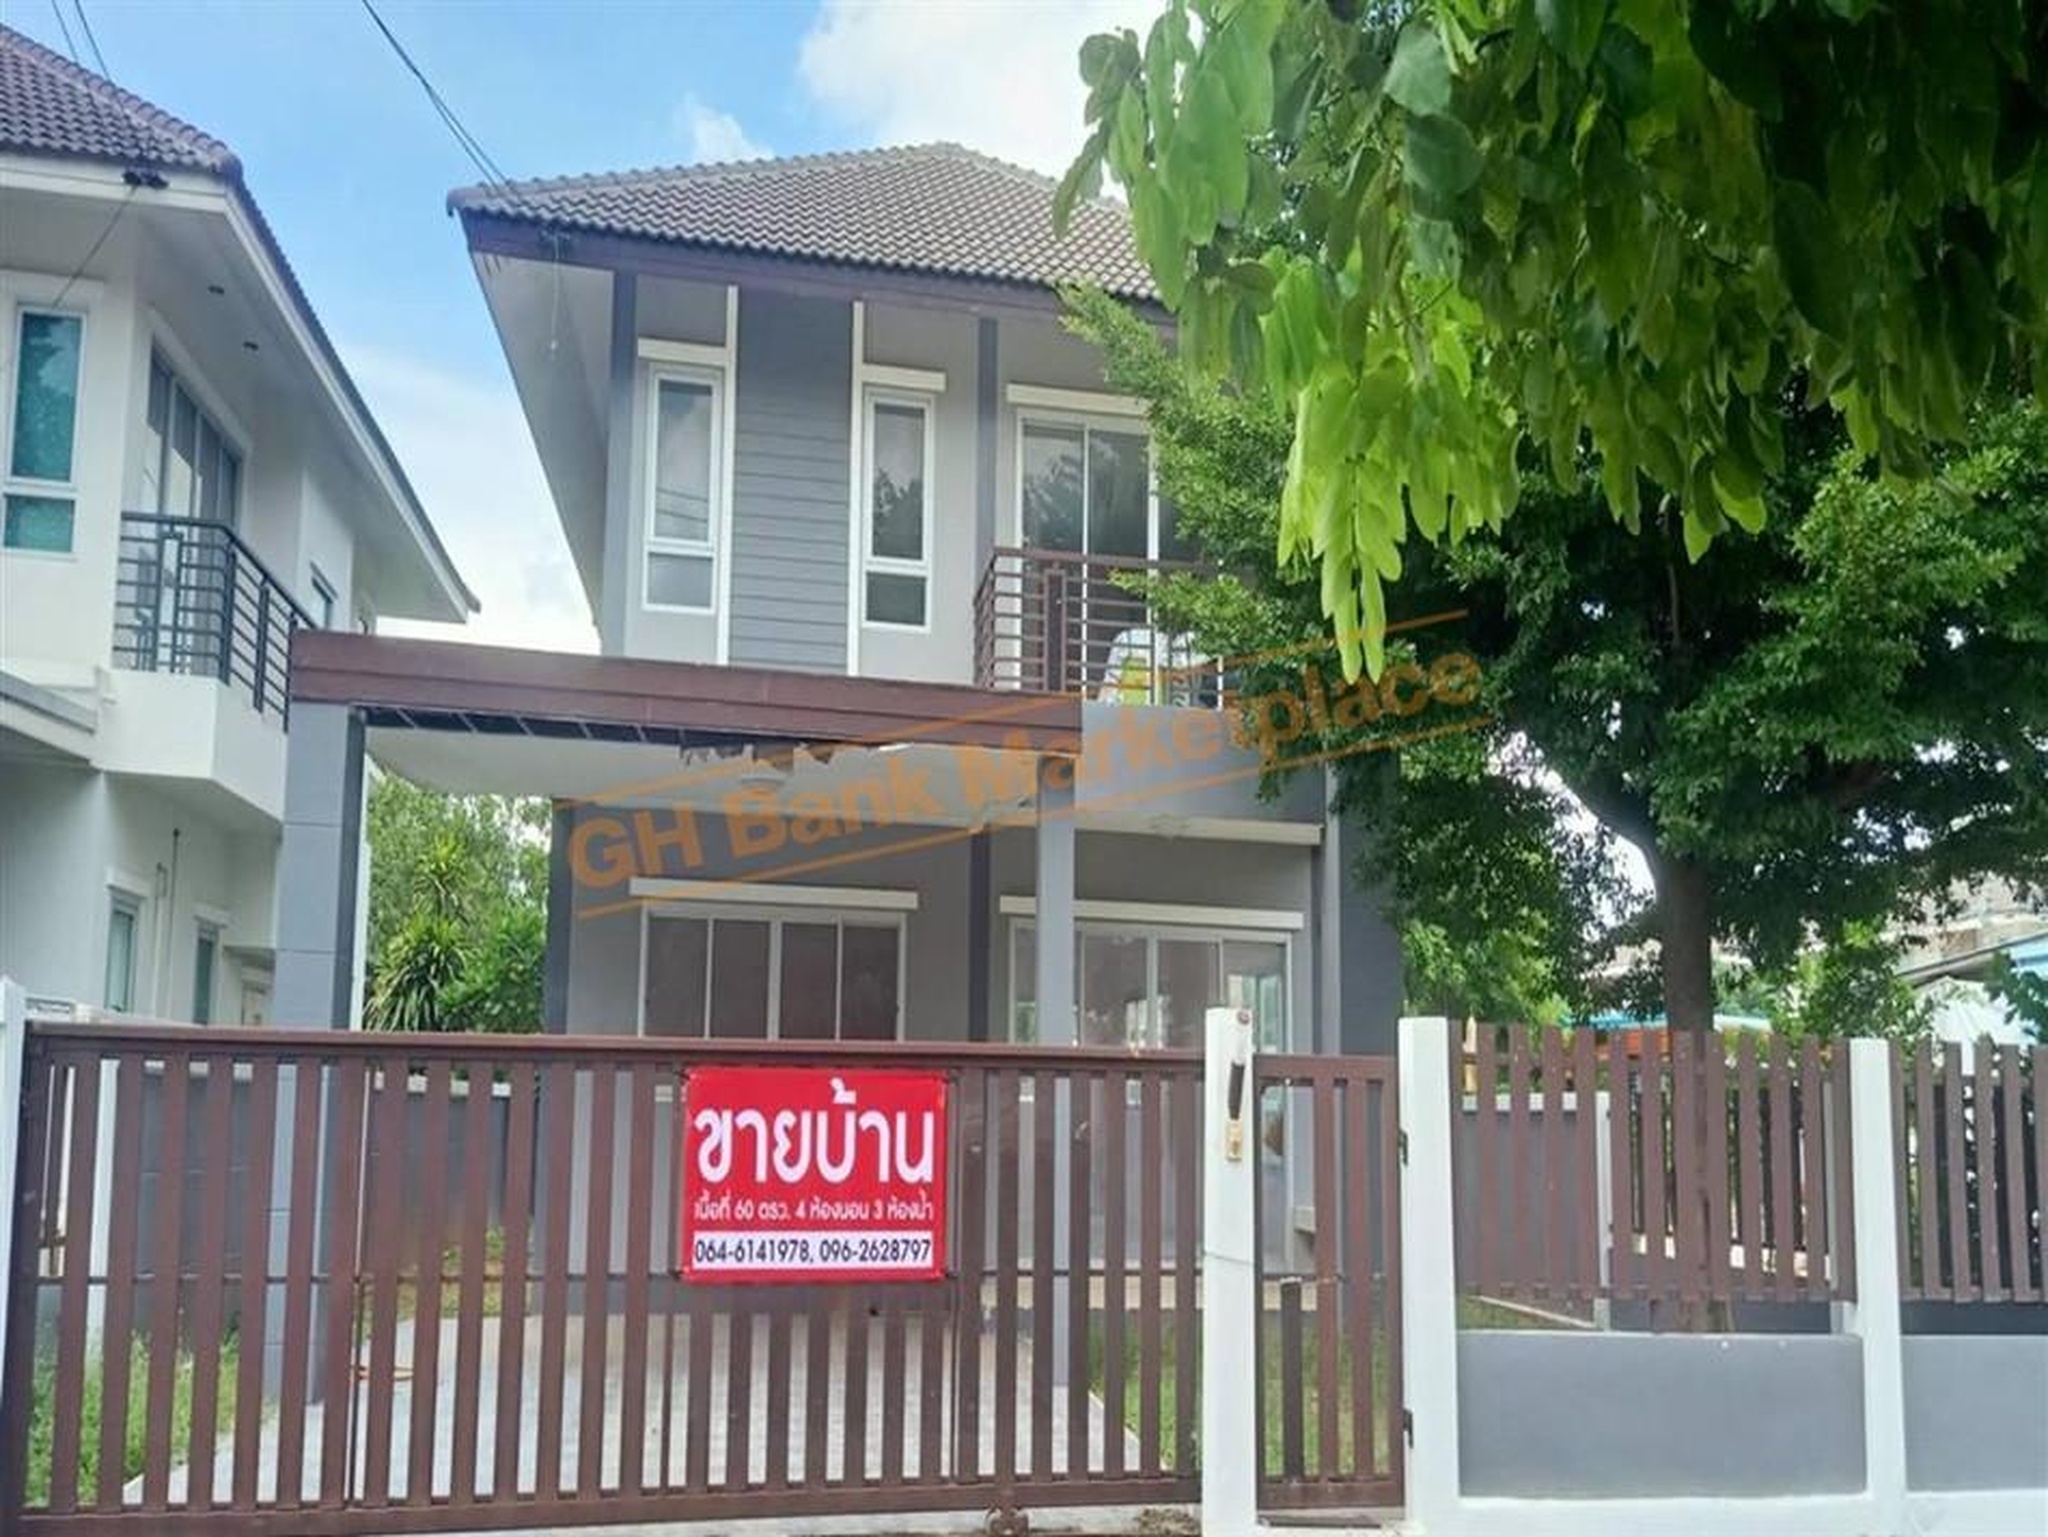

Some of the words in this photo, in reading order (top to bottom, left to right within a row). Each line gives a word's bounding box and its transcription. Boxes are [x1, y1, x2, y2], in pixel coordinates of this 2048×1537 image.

[694, 1077, 935, 1184] ขายบ้าน
[694, 1188, 732, 1220] เนื้อที่
[734, 1199, 754, 1220] 60
[795, 1200, 806, 1219] 4
[810, 1195, 870, 1220] ห้องนอน
[873, 1199, 883, 1220] 3
[887, 1187, 934, 1220] ห้องน้ำ
[695, 1239, 814, 1263] 064-6141978,
[820, 1239, 931, 1262] 096-2628797
